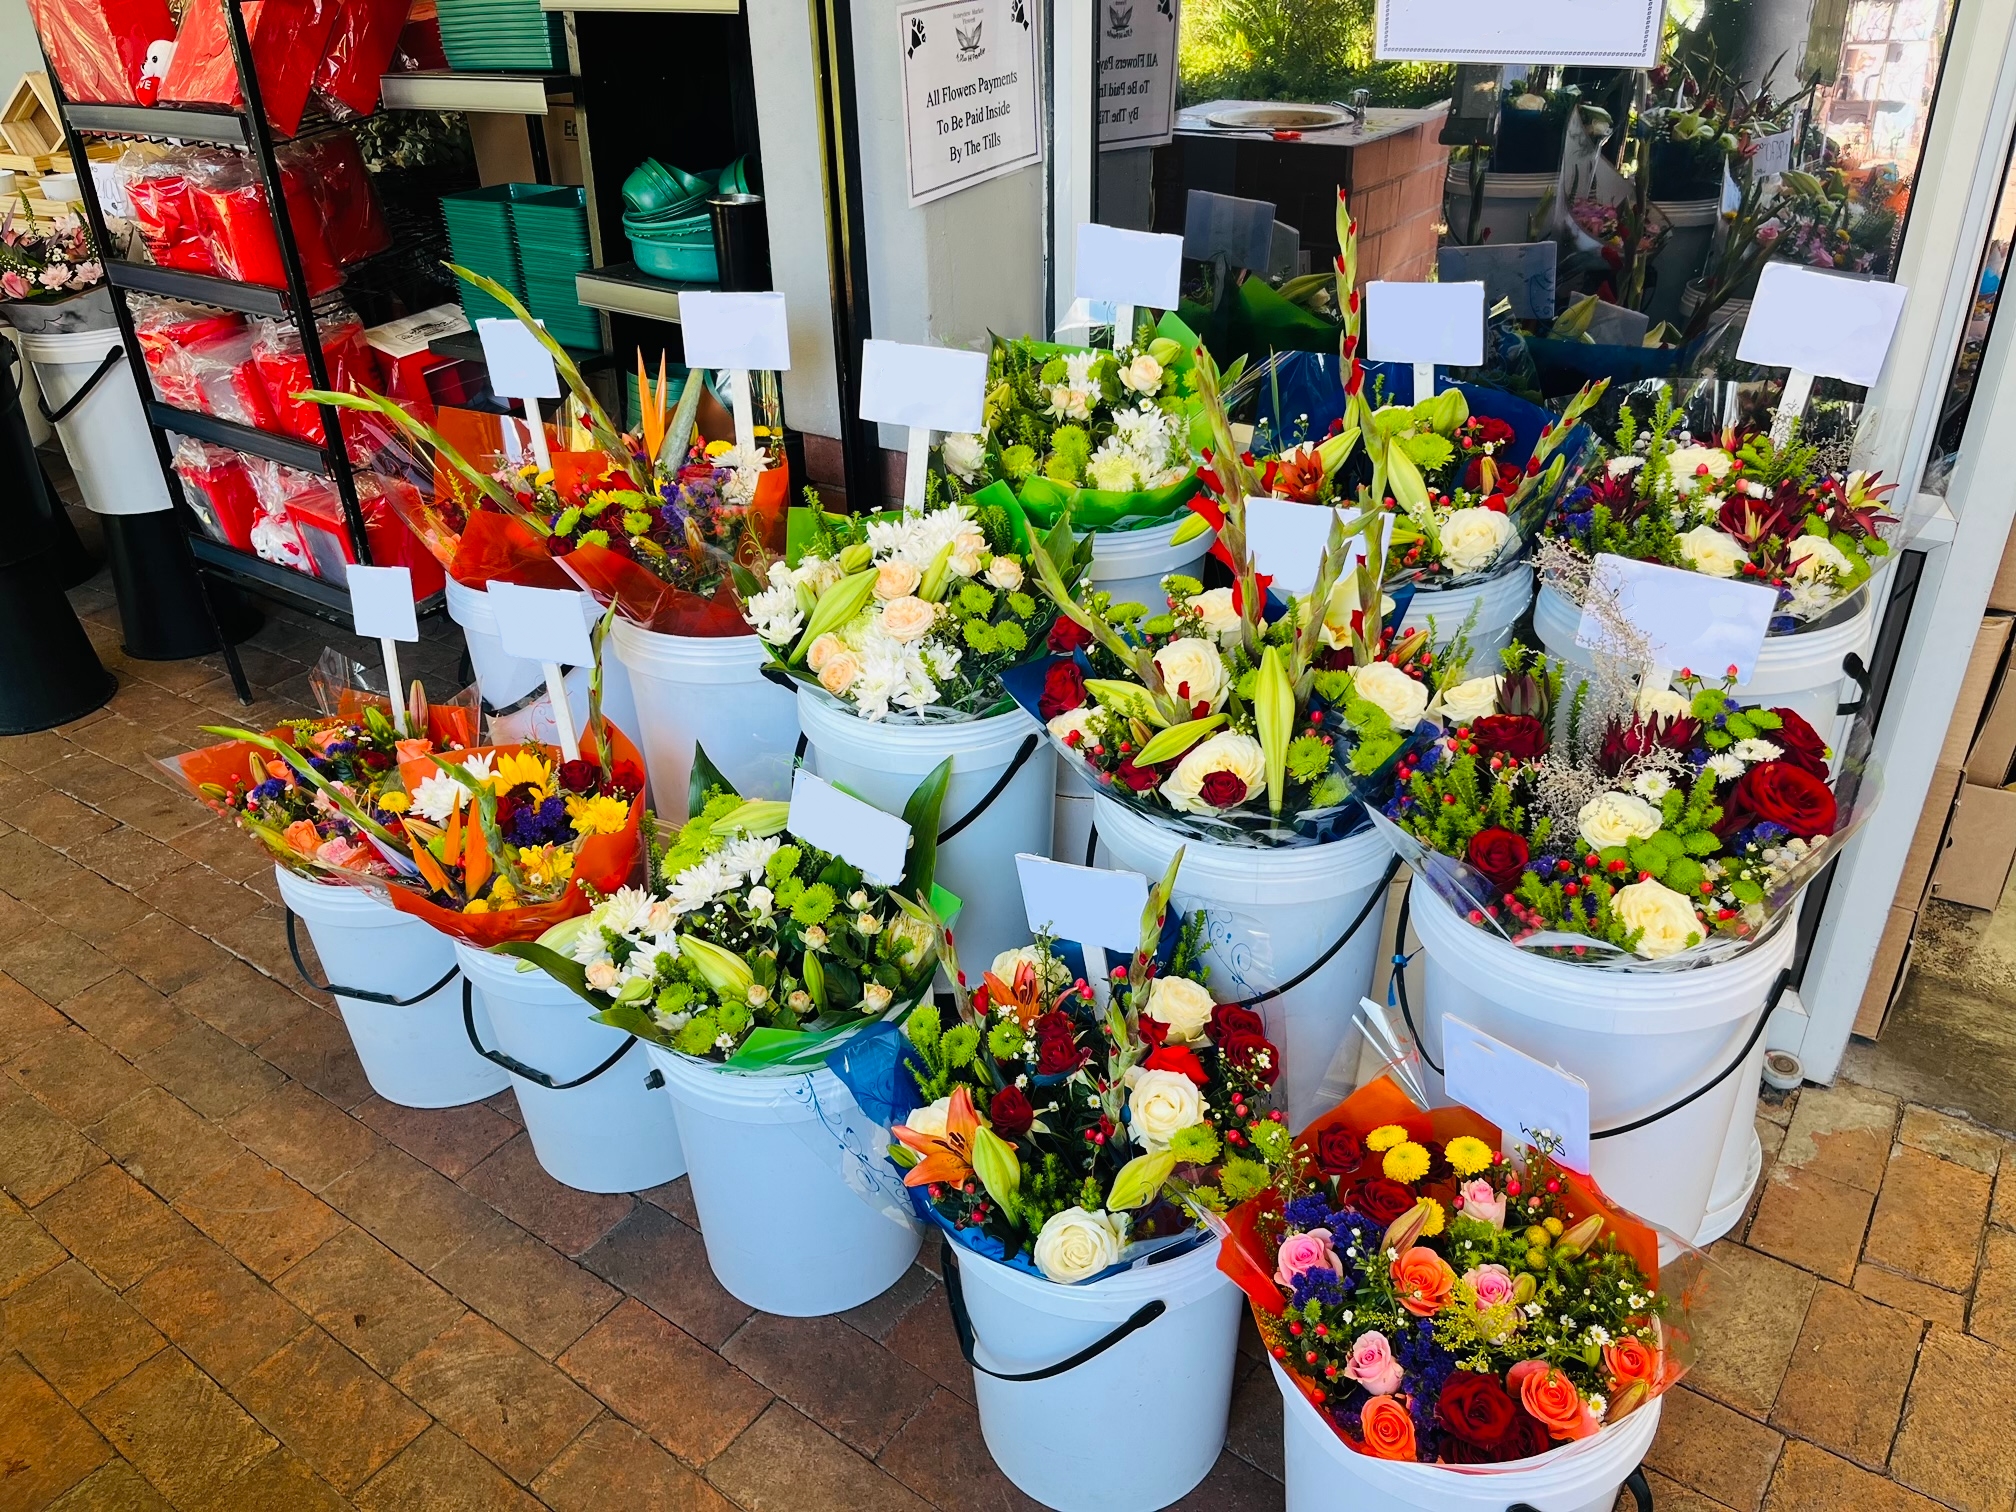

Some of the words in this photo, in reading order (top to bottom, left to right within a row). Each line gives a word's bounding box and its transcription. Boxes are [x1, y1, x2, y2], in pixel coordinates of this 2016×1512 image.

[926, 90, 940, 109] All
[942, 83, 977, 103] Flowers
[978, 71, 1018, 93] Payments
[936, 119, 949, 135] To
[951, 114, 964, 130] Be
[965, 109, 984, 127] Paid
[985, 100, 1011, 121] Inside
[949, 146, 962, 164] By
[964, 139, 981, 157] The
[982, 132, 1002, 151] Tills
